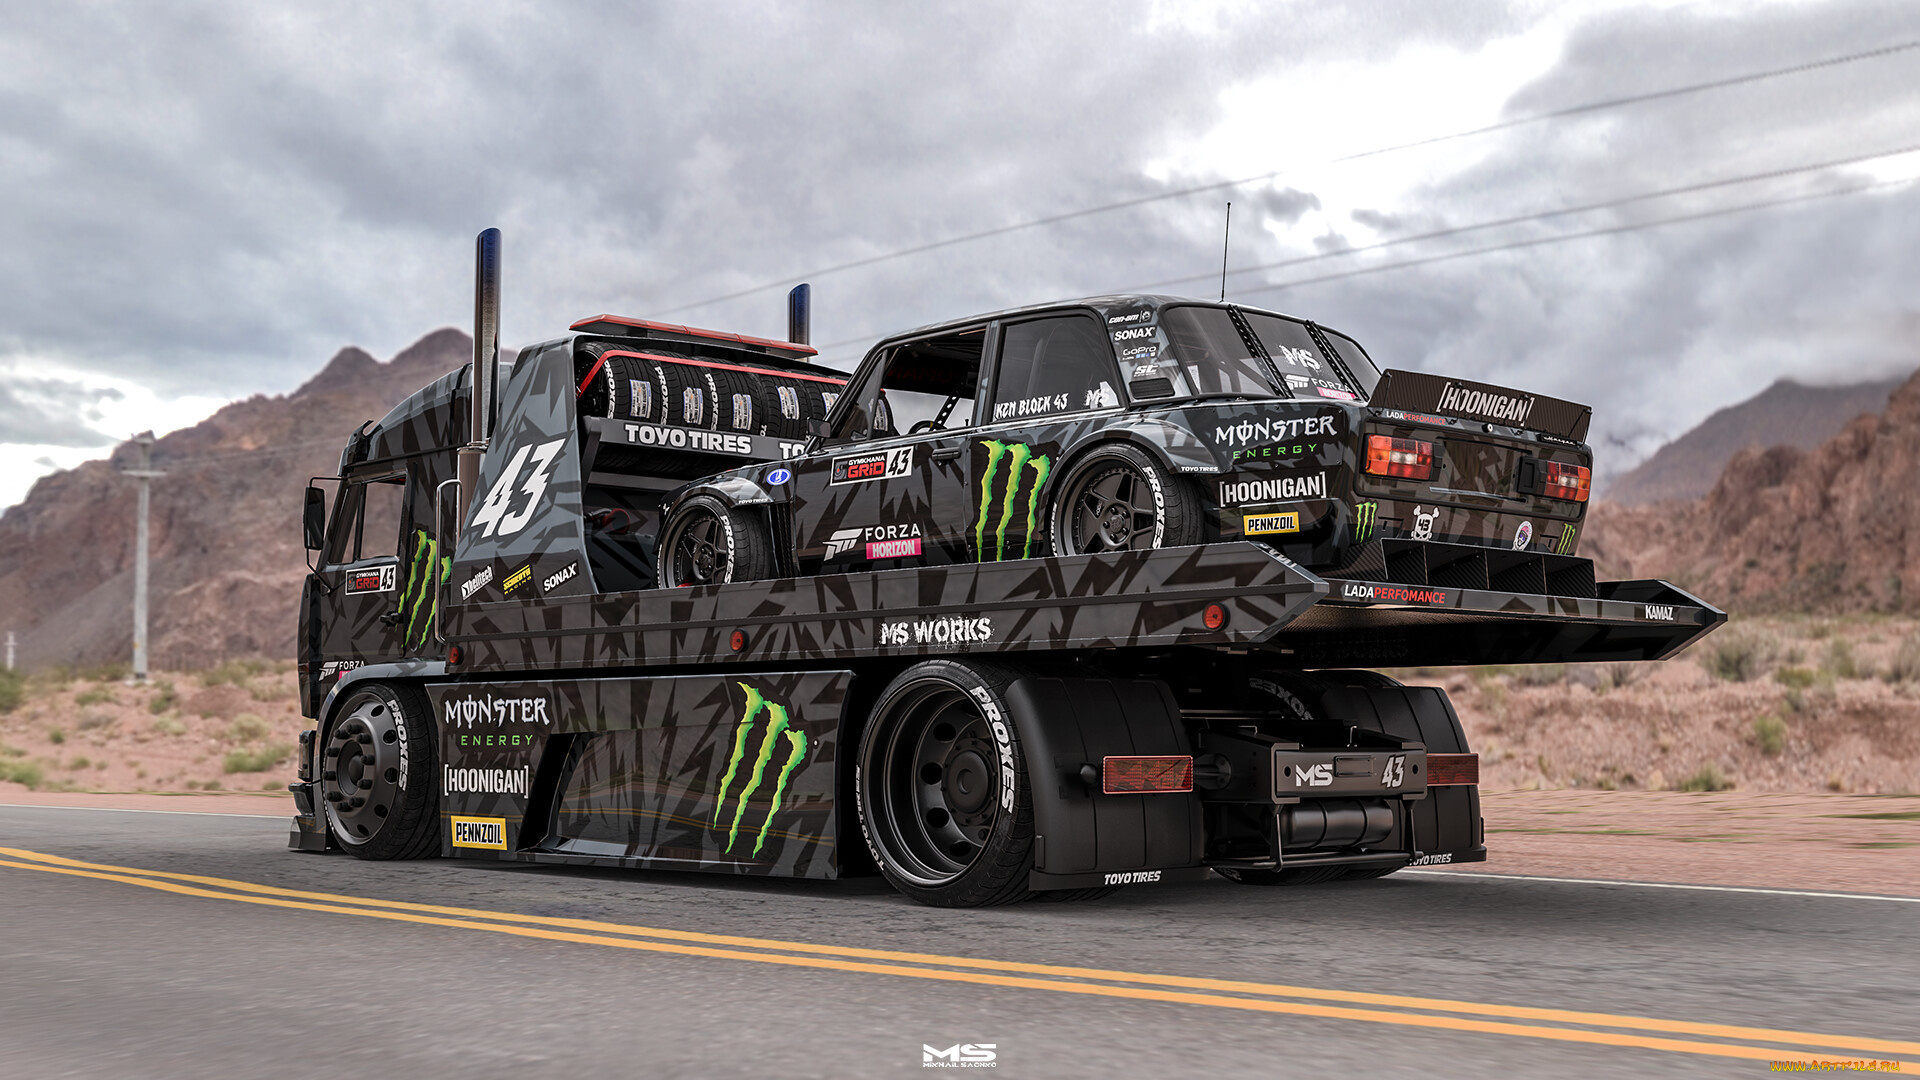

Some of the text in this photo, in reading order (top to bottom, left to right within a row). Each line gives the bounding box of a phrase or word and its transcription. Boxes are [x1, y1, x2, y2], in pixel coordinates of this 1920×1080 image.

[1114, 327, 1153, 341] SONAX
[1122, 346, 1157, 356] GoPro
[1279, 345, 1321, 371] MS
[1310, 377, 1354, 393] FORZA
[1018, 396, 1051, 416] BLOCK
[1053, 392, 1070, 411] 43
[625, 424, 751, 454] TOYO TIRES
[1215, 415, 1338, 447] MONSTER
[848, 455, 885, 466] GYMKHANA
[888, 448, 912, 476] 43
[1232, 443, 1318, 459] ENERGY
[471, 438, 566, 539] 43
[1142, 466, 1165, 550] PROXES
[865, 523, 921, 541] FORZA
[1248, 516, 1295, 532] PENNZOIL
[1418, 518, 1431, 531] 43
[720, 515, 735, 584] PROXES
[872, 540, 915, 558] HORIZON
[381, 567, 395, 590] 43
[543, 562, 577, 592] SONAX
[1645, 604, 1674, 621] KAMAZ
[880, 617, 992, 647] MS WORKS
[445, 693, 550, 729] MONSTER
[387, 699, 410, 792] PROXES
[461, 735, 534, 746] ENERGY
[970, 685, 1015, 814] PROXES
[1296, 763, 1334, 787] MS
[1381, 754, 1406, 788] 43
[455, 822, 504, 845] PENNZOIL
[1430, 853, 1453, 864] TIRES
[1104, 870, 1162, 885] TOYO TIRES
